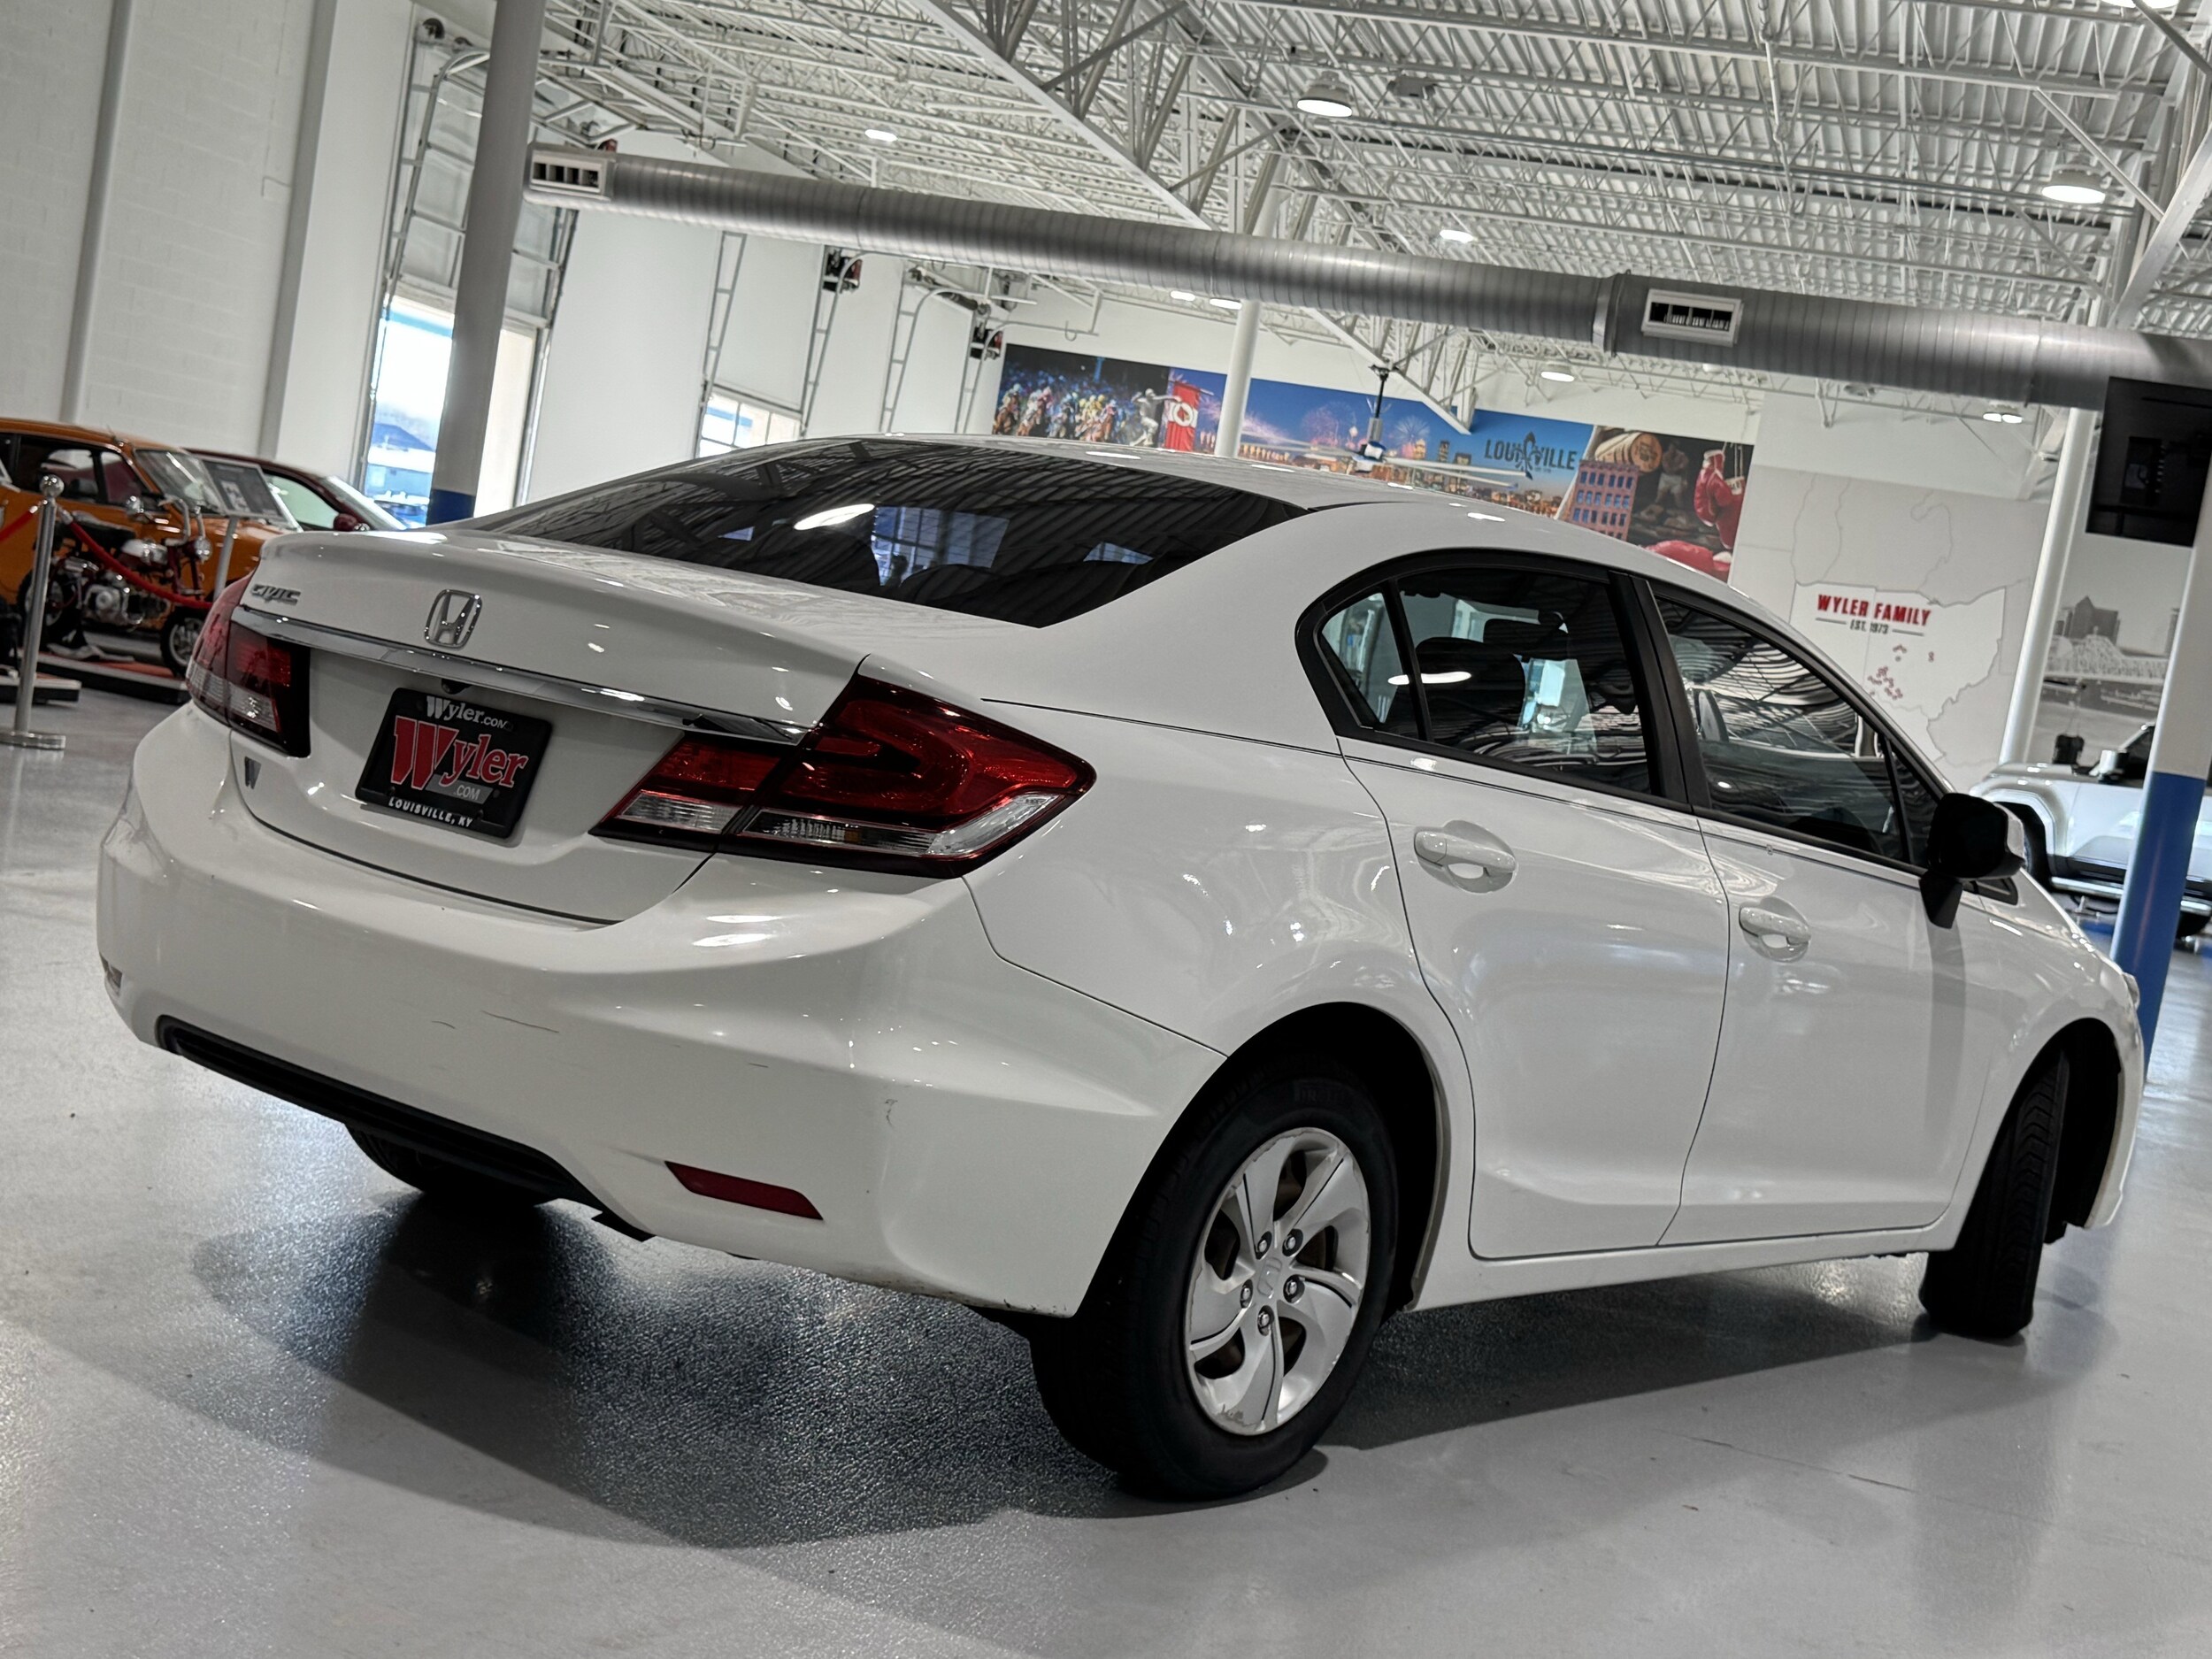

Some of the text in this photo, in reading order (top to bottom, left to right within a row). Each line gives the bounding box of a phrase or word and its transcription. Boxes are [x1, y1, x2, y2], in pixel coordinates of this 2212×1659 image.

[251, 584, 301, 605] CIVIC
[1817, 594, 1932, 626] WYLER FAMILY
[1849, 619, 1889, 634] EST. 1973
[391, 715, 529, 790] Wyler
[388, 796, 473, 828] LOUISVILLE, KY
